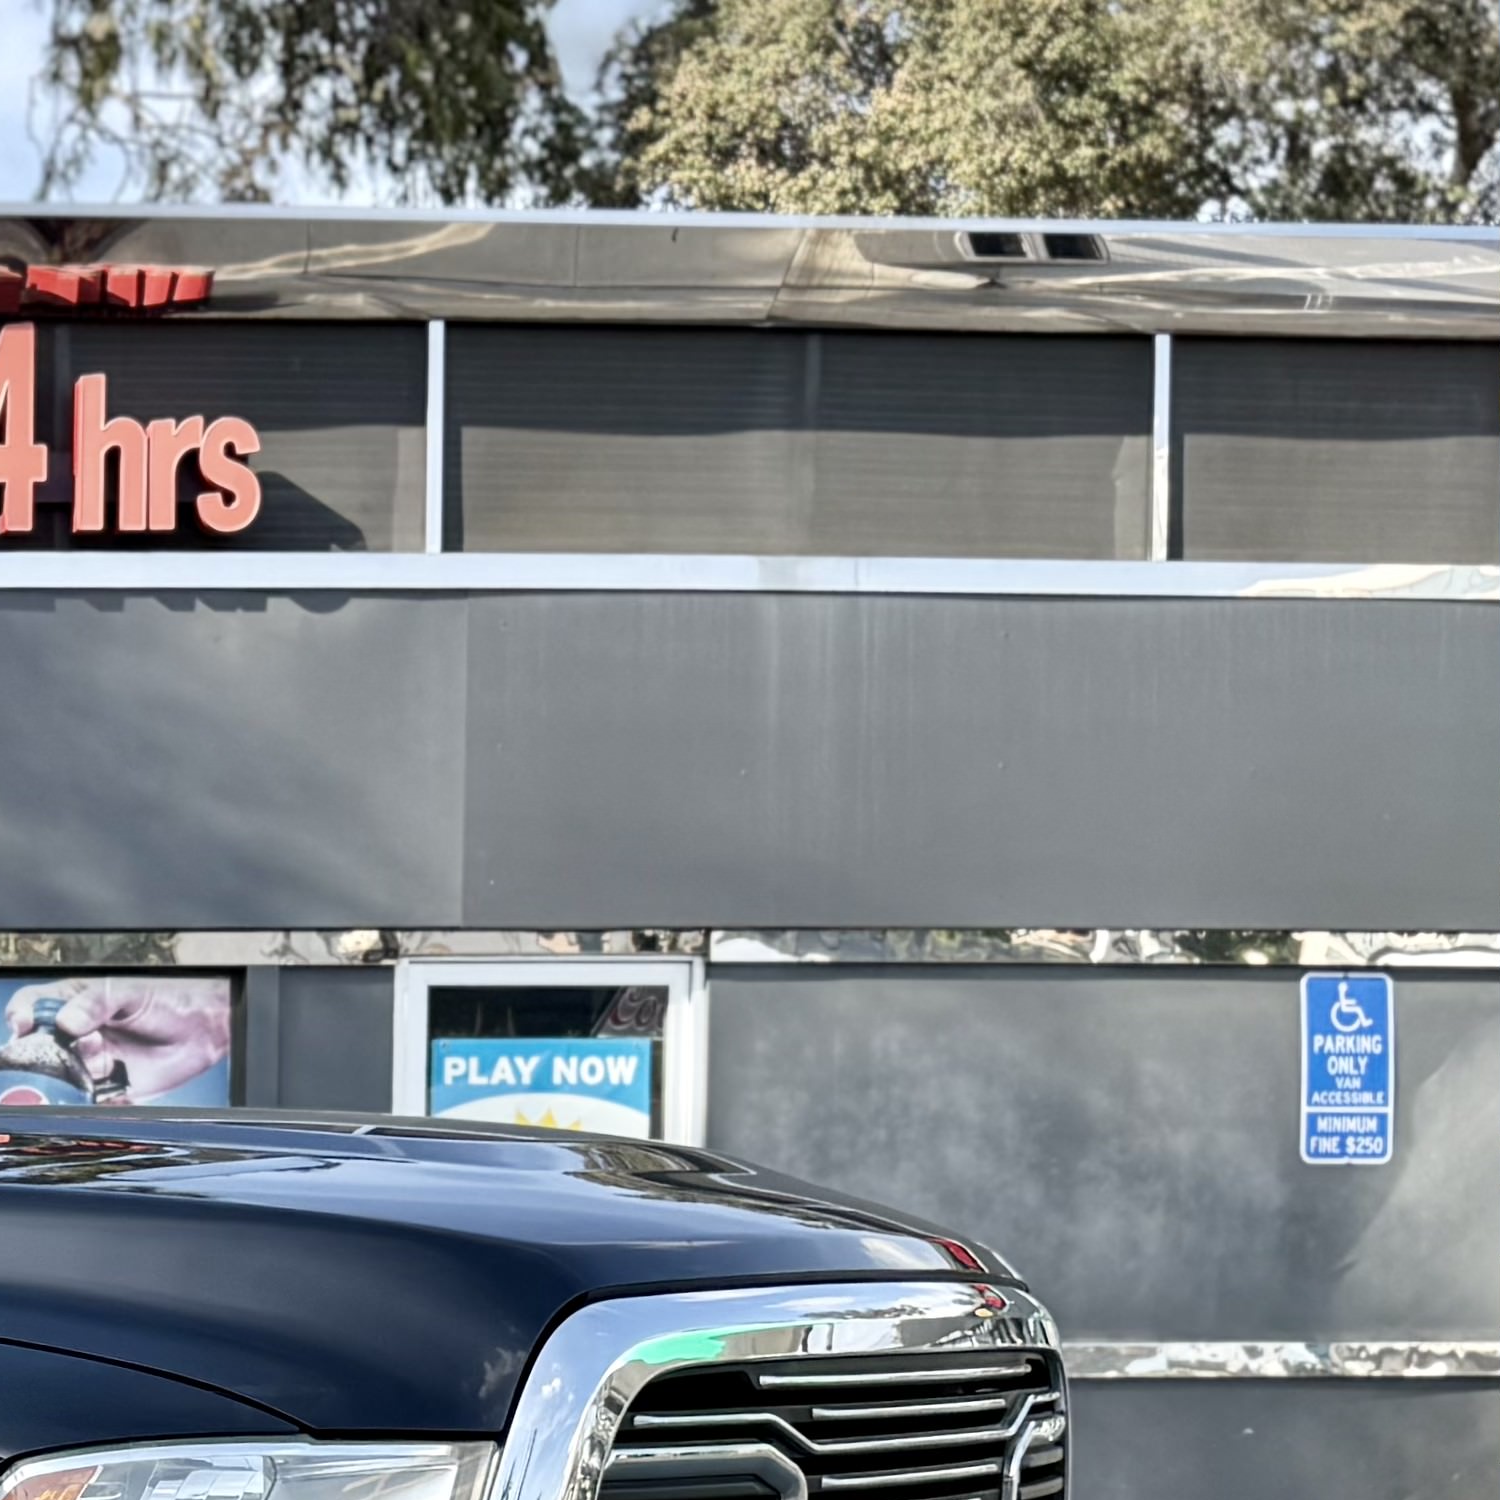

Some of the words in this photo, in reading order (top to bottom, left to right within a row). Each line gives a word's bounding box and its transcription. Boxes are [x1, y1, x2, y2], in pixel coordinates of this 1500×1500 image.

[72, 372, 261, 534] hrs
[1313, 1034, 1382, 1055] PARKING
[443, 1056, 541, 1086] PLAY
[552, 1056, 639, 1086] NOW
[1327, 1056, 1368, 1076] ONLY
[1335, 1076, 1361, 1090] VAN
[1311, 1091, 1384, 1105] ACCESSIBLE
[1317, 1116, 1377, 1133] MINIMUM
[1310, 1136, 1341, 1153] FINE
[1346, 1136, 1383, 1154] $250
